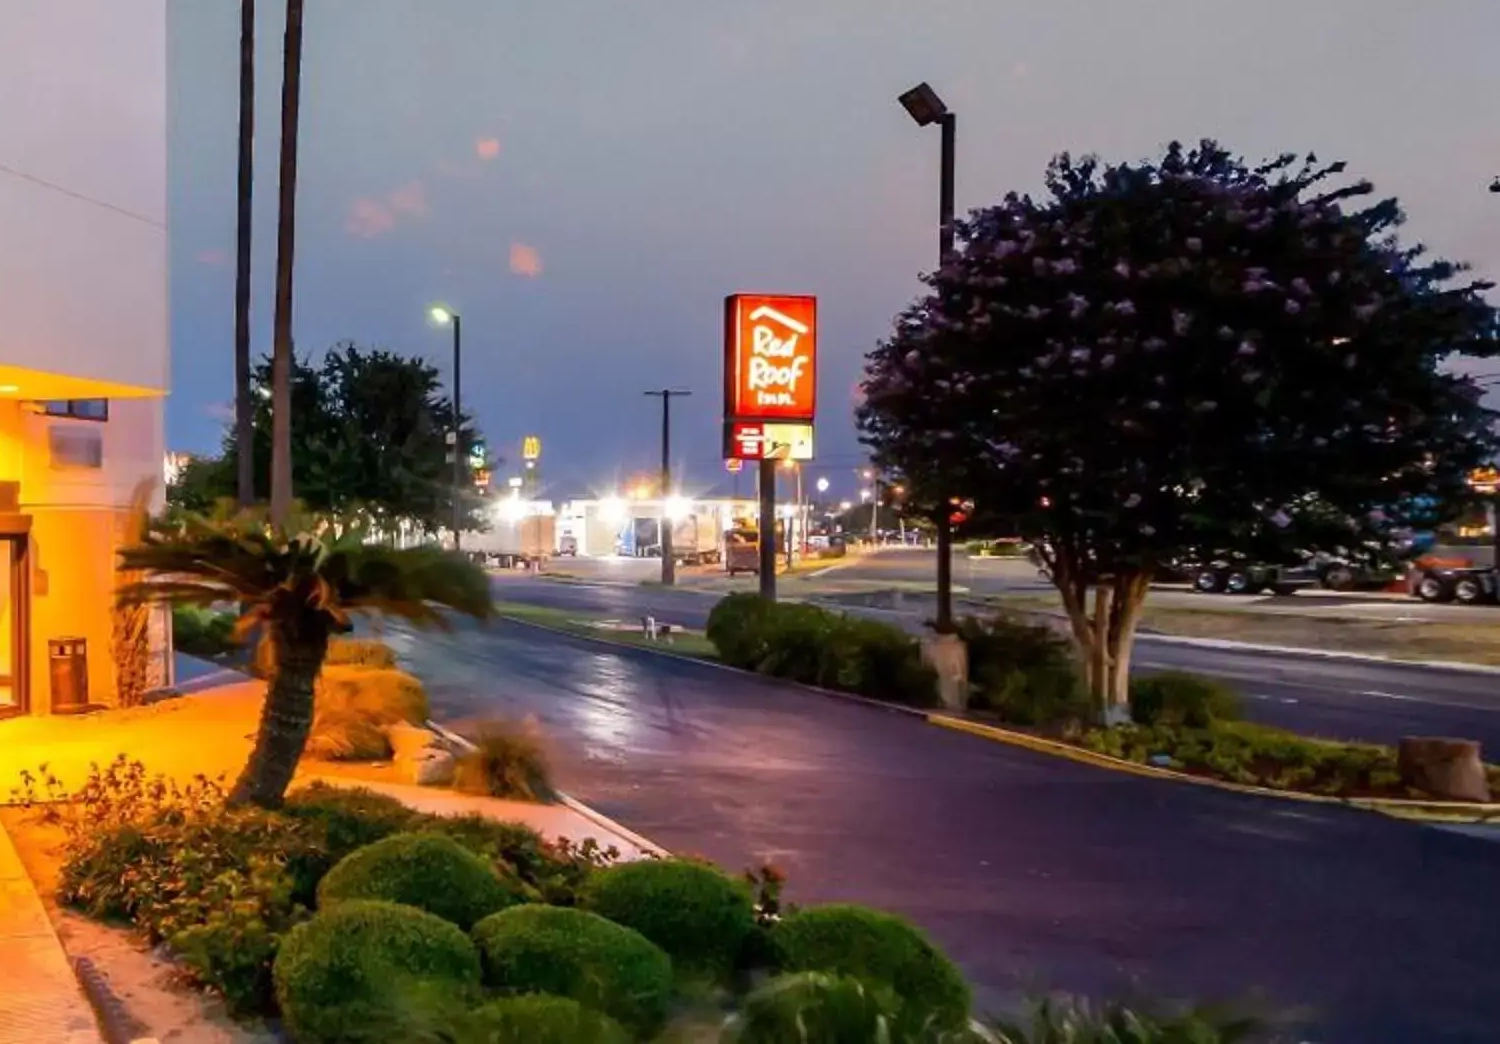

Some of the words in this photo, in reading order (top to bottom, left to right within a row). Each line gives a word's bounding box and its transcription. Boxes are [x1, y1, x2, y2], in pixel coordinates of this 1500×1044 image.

[753, 324, 798, 357] Red
[749, 356, 808, 391] Roof
[758, 391, 795, 405] Inn
